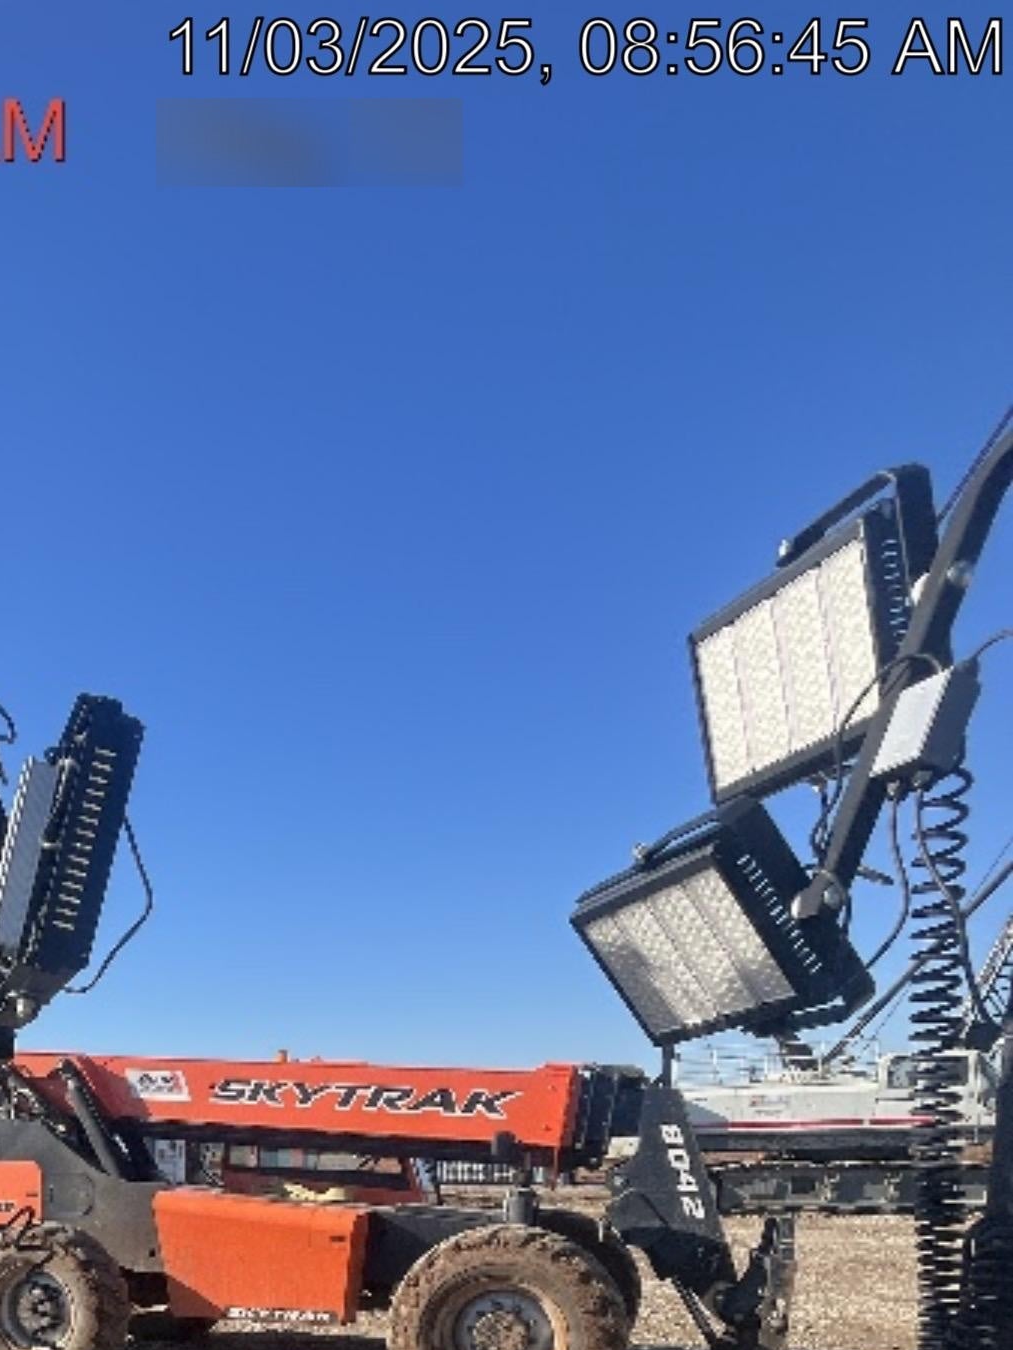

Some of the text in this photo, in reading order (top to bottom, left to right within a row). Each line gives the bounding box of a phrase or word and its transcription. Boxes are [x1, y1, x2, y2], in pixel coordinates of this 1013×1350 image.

[210, 1079, 523, 1119] SKYTRAK
[659, 1124, 705, 1219] 8042
[226, 1306, 331, 1324] SKYTRAK
